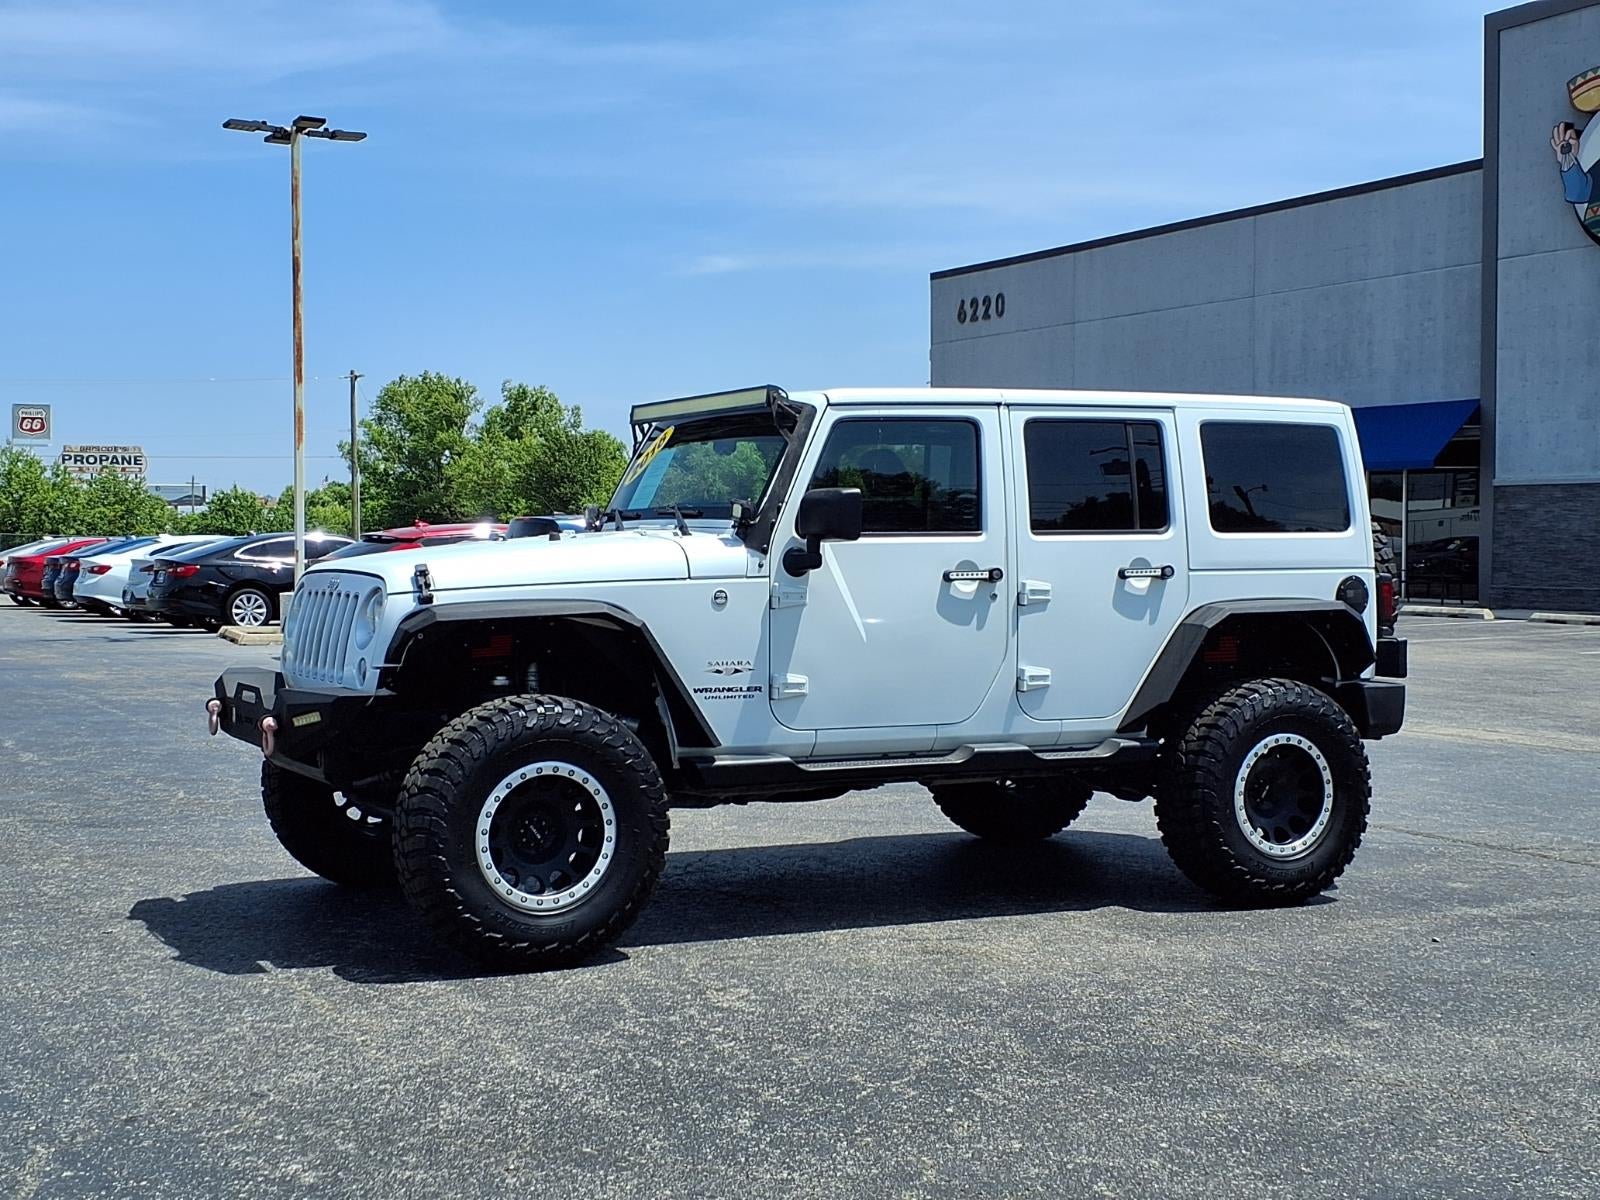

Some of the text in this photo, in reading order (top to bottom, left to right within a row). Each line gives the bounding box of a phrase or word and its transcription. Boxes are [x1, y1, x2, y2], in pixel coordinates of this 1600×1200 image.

[957, 292, 1005, 325] 6220
[22, 418, 42, 430] 66
[61, 454, 143, 466] PROPANE
[693, 686, 762, 694] WRANGLER
